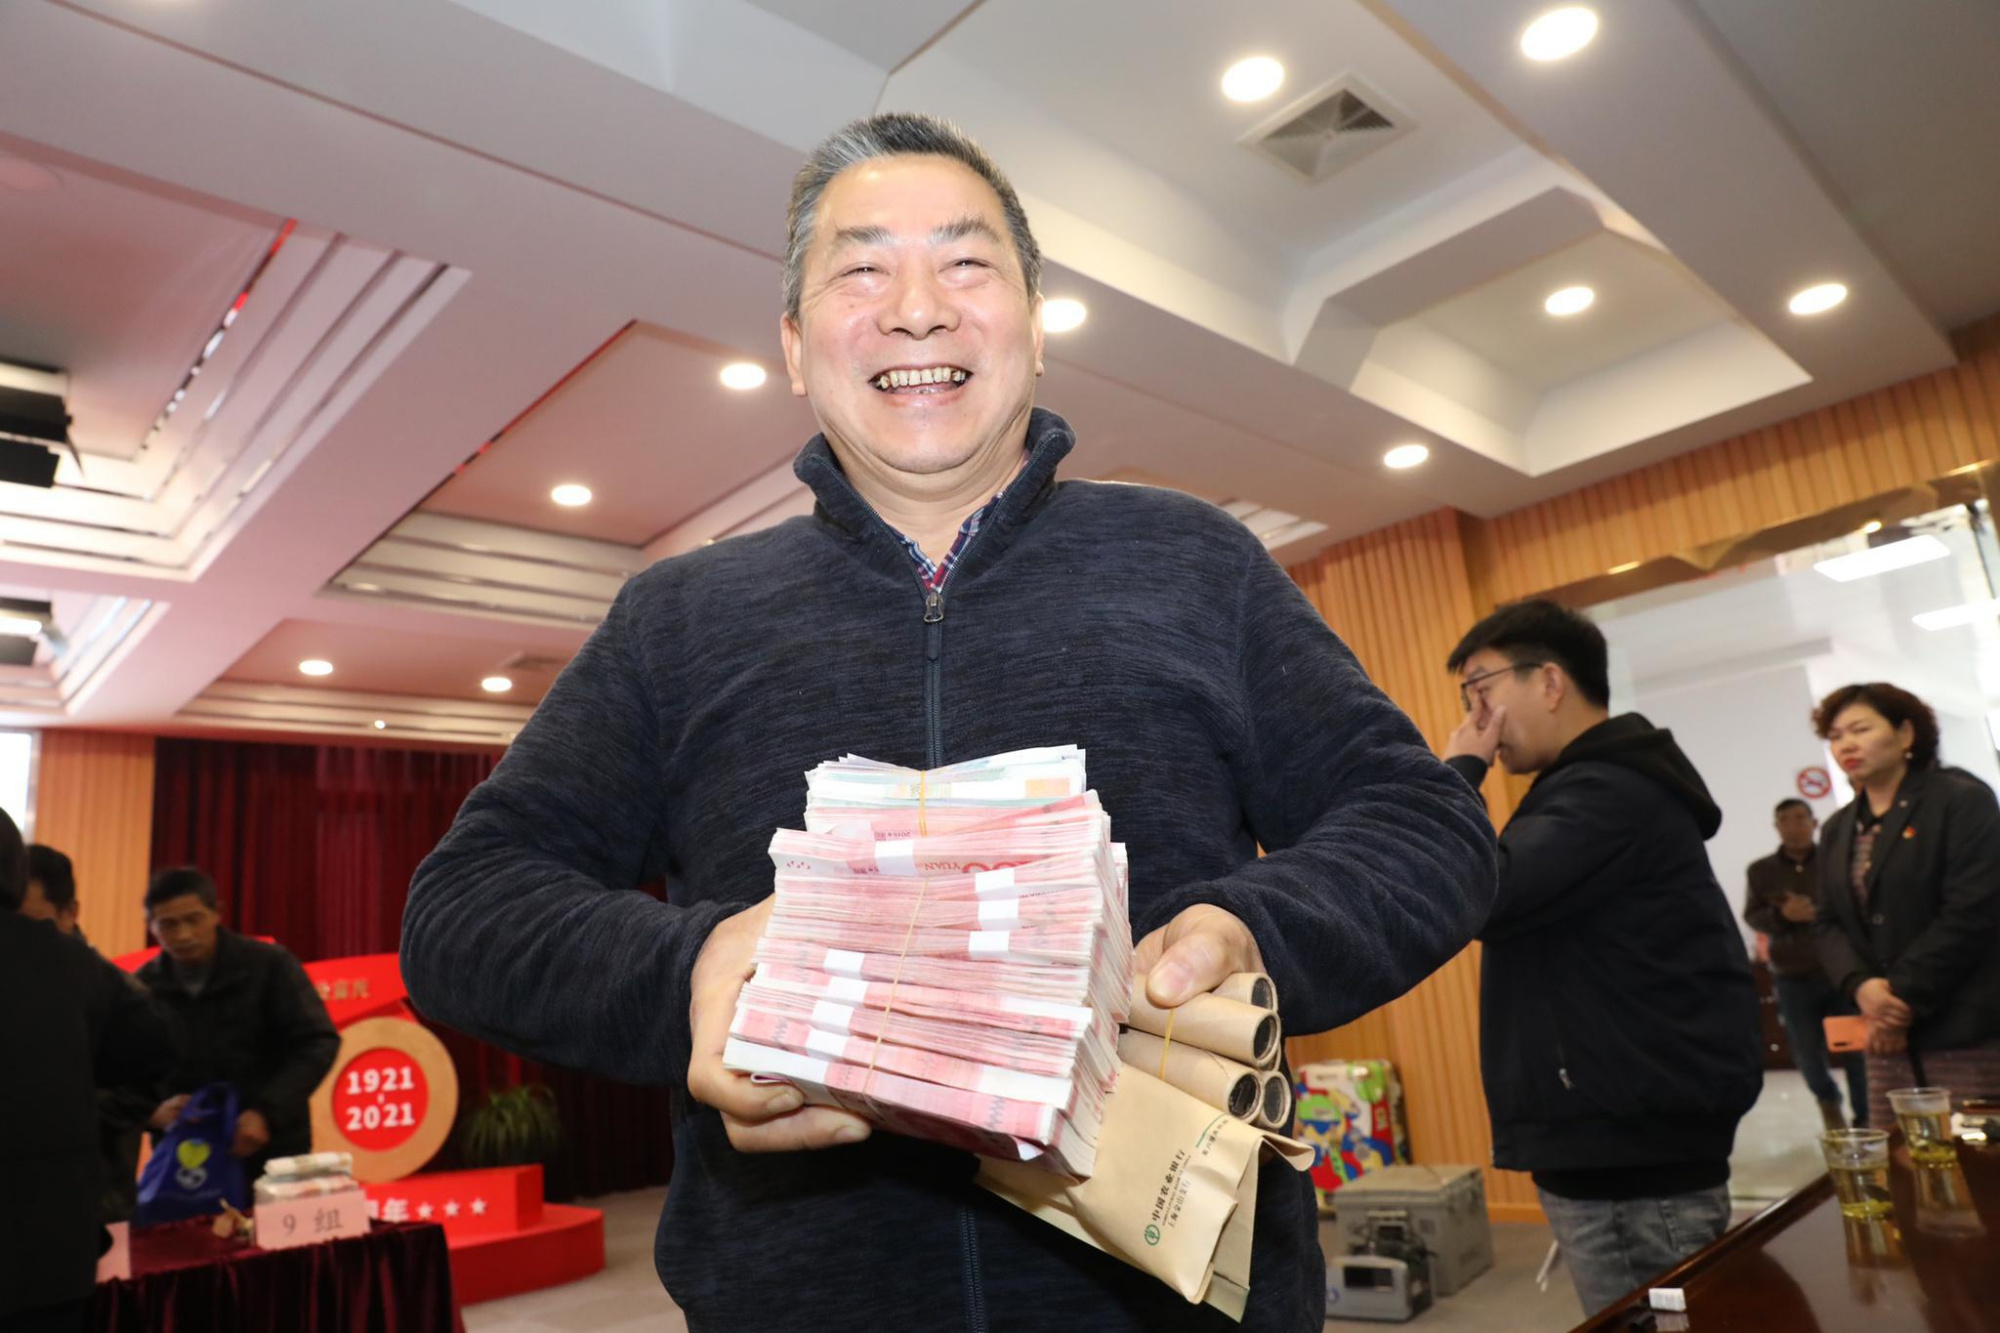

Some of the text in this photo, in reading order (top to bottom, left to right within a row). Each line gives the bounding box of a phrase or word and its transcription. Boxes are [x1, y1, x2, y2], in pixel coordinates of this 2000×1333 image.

[924, 861, 961, 871] YUAN
[346, 1066, 414, 1095] 1921
[346, 1102, 416, 1131] 2021
[1152, 1149, 1185, 1221] 中国农业银行
[282, 1208, 343, 1236] 9 组
